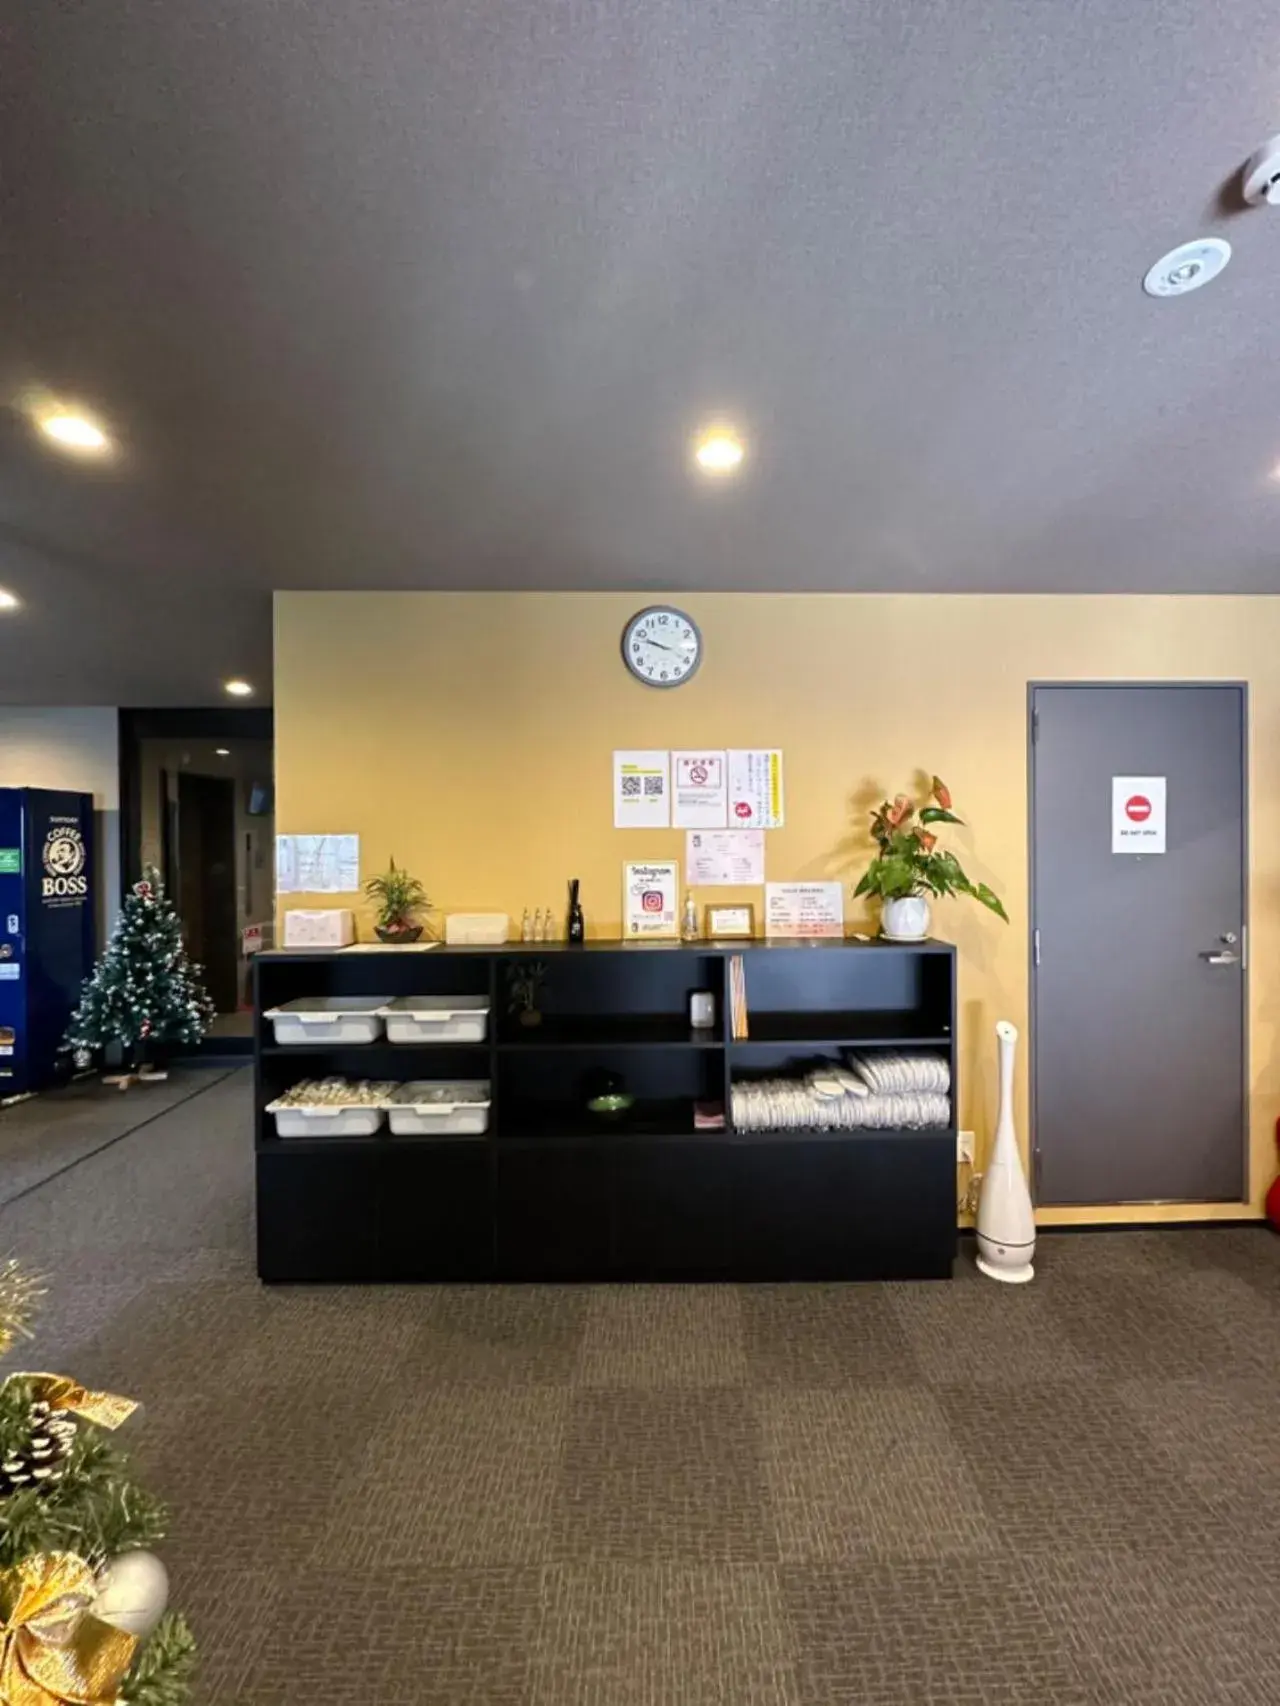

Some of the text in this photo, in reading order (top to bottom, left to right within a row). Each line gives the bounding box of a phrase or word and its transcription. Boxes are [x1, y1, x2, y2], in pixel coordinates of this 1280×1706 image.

[646, 618, 654, 628] 11
[657, 615, 669, 625] 12
[635, 629, 647, 638] 10
[683, 629, 691, 639] 2
[632, 643, 640, 653] 9
[636, 657, 644, 666] 8
[683, 656, 690, 665] 4
[647, 666, 654, 676] 7
[660, 670, 668, 680] 6
[674, 666, 681, 676] 5
[47, 827, 81, 841] COFFEE
[632, 865, 671, 878] Instagram
[42, 876, 87, 896] BOSS
